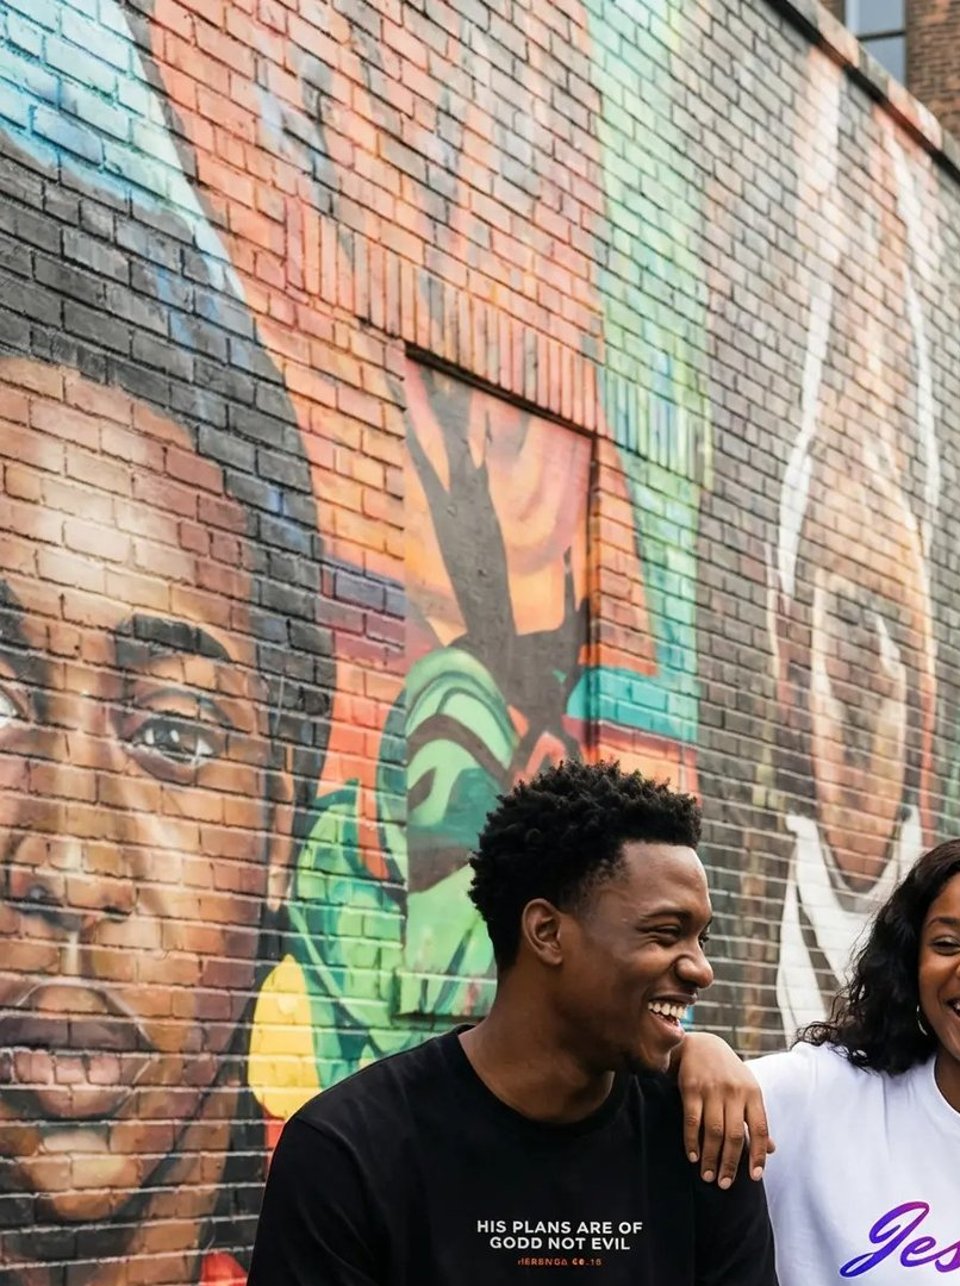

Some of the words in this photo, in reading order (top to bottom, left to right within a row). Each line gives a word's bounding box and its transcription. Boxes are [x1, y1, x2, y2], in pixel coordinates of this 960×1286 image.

[476, 1220, 507, 1233] HIS
[512, 1221, 571, 1234] PLANS
[576, 1221, 612, 1234] ARE
[618, 1222, 643, 1235] OF
[489, 1236, 543, 1249] GODD
[548, 1237, 586, 1250] NOT
[591, 1237, 631, 1250] EVIL
